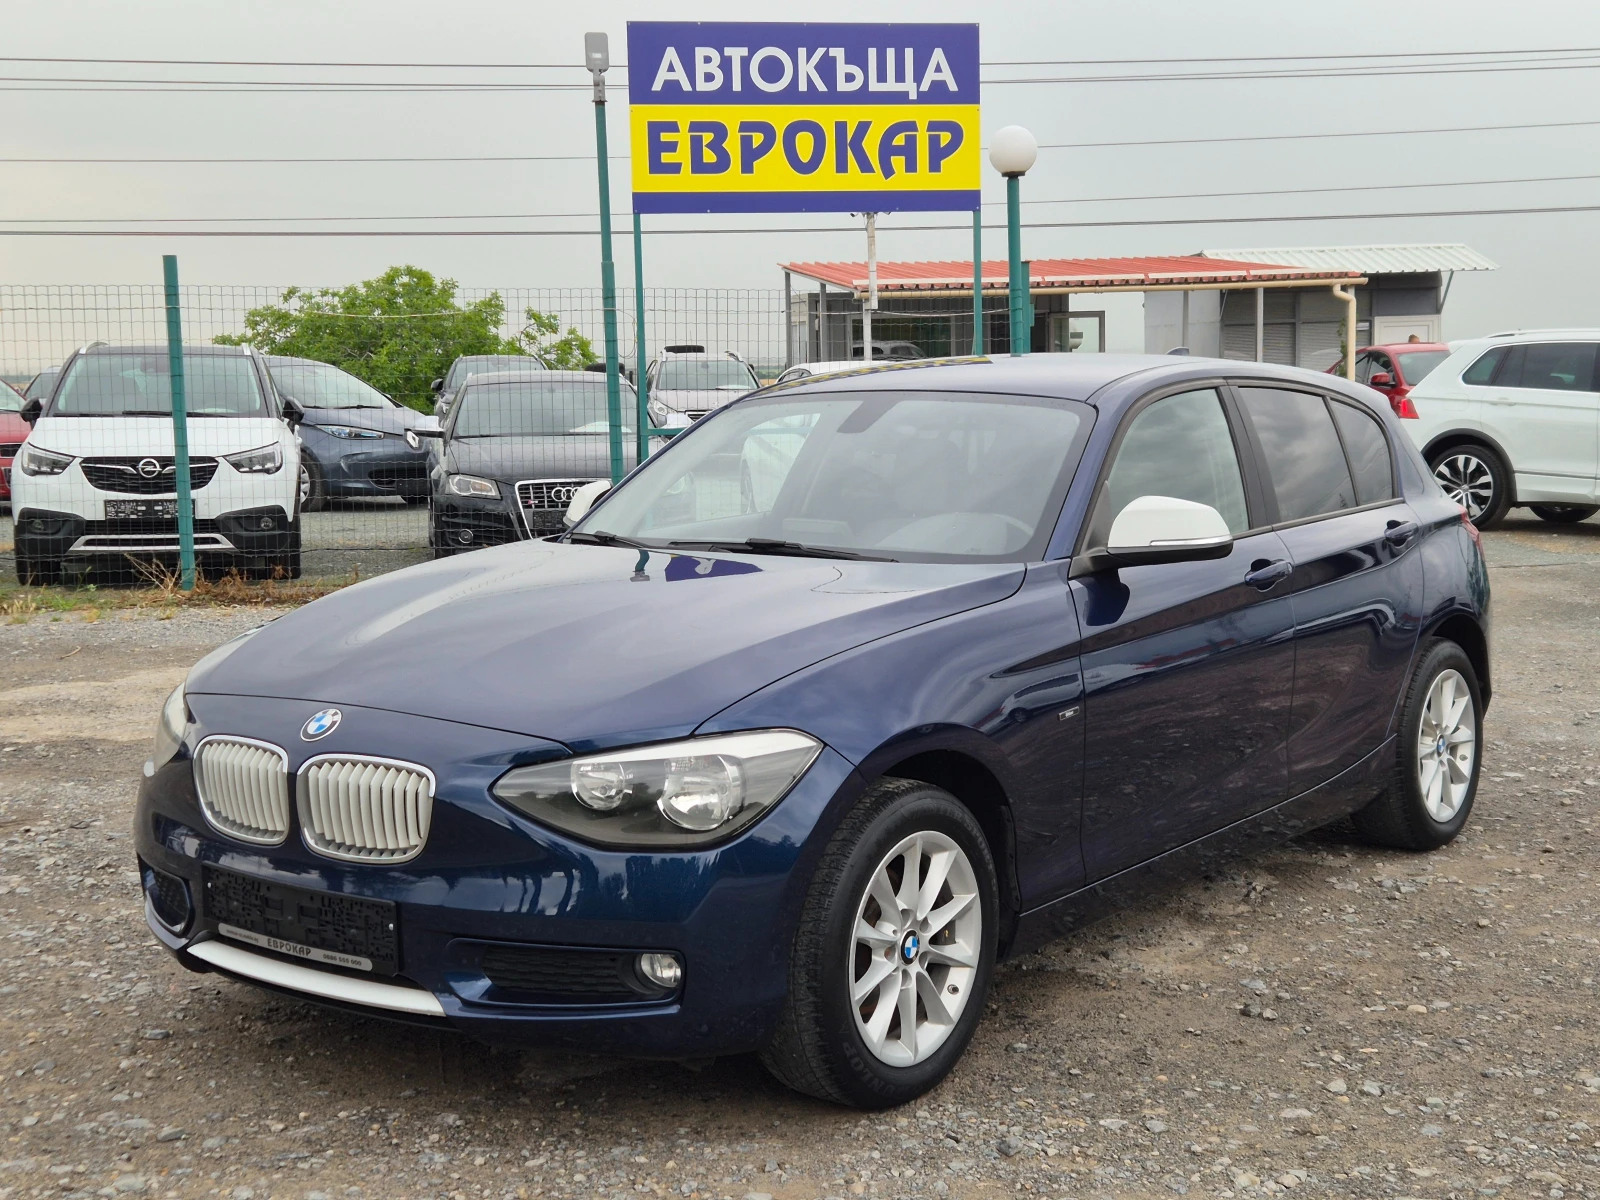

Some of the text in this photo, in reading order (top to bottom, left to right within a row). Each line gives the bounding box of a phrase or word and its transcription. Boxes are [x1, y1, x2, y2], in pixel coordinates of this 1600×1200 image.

[651, 46, 958, 100] АВТОКЪЩА
[647, 119, 965, 181] ЕВРОКАР
[267, 938, 311, 956] ЕВРОКАР
[842, 1041, 908, 1098] UNLOP
